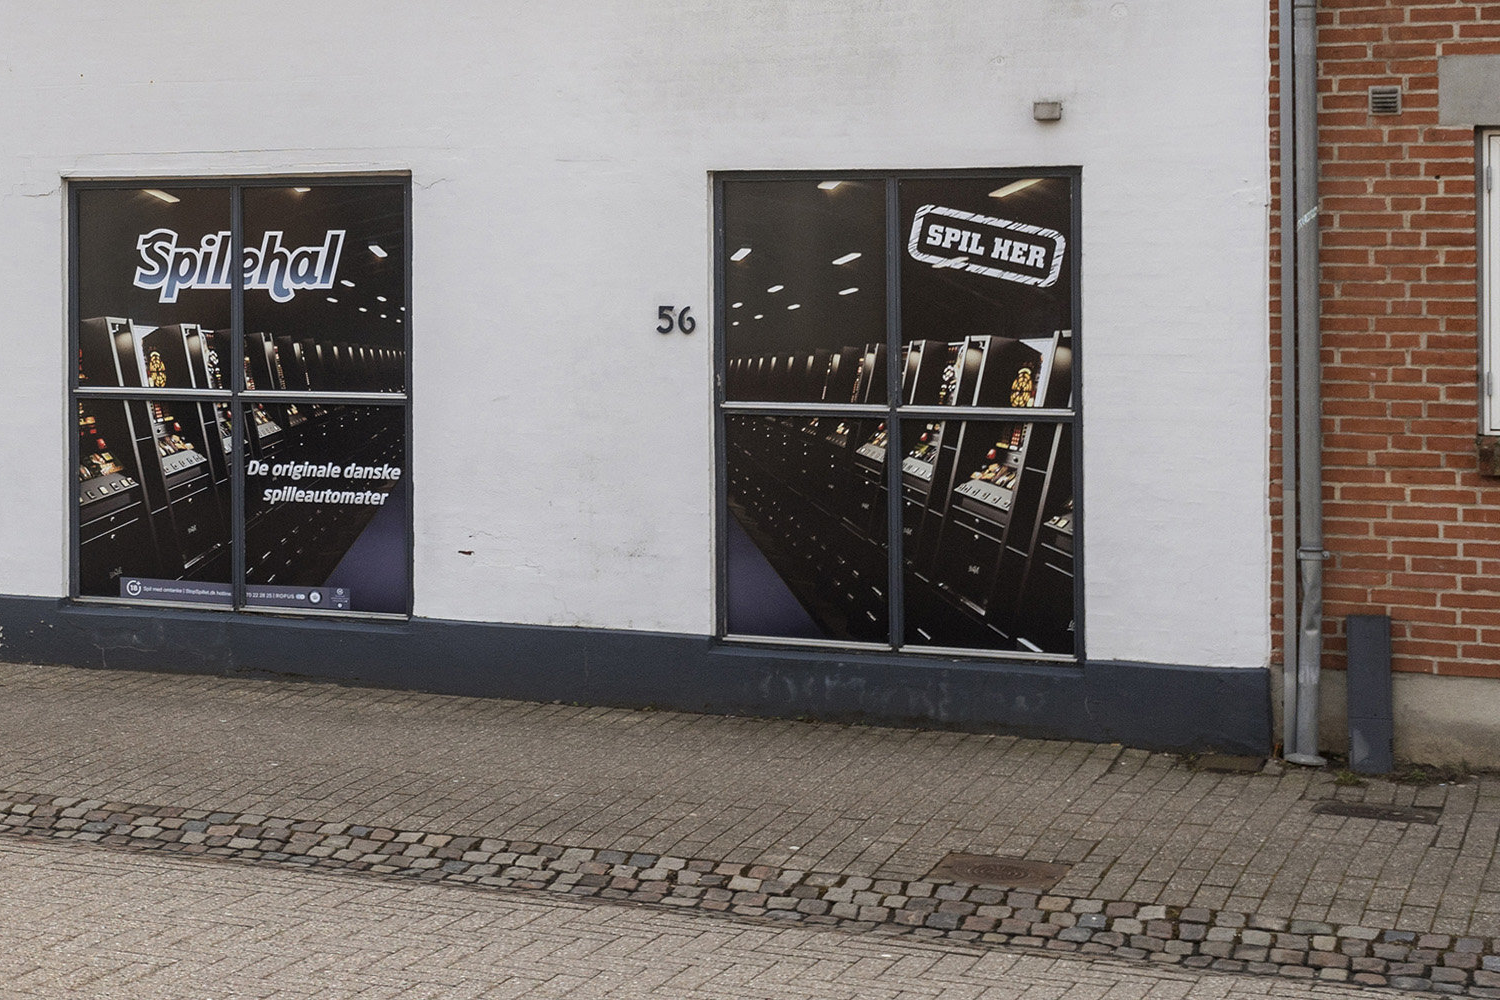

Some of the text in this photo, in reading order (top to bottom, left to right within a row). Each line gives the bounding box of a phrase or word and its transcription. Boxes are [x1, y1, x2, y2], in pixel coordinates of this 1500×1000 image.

[926, 224, 1047, 269] SPIL HER
[656, 305, 696, 335] 56
[247, 460, 402, 480] De originale danske
[263, 486, 389, 505] spilleautomater
